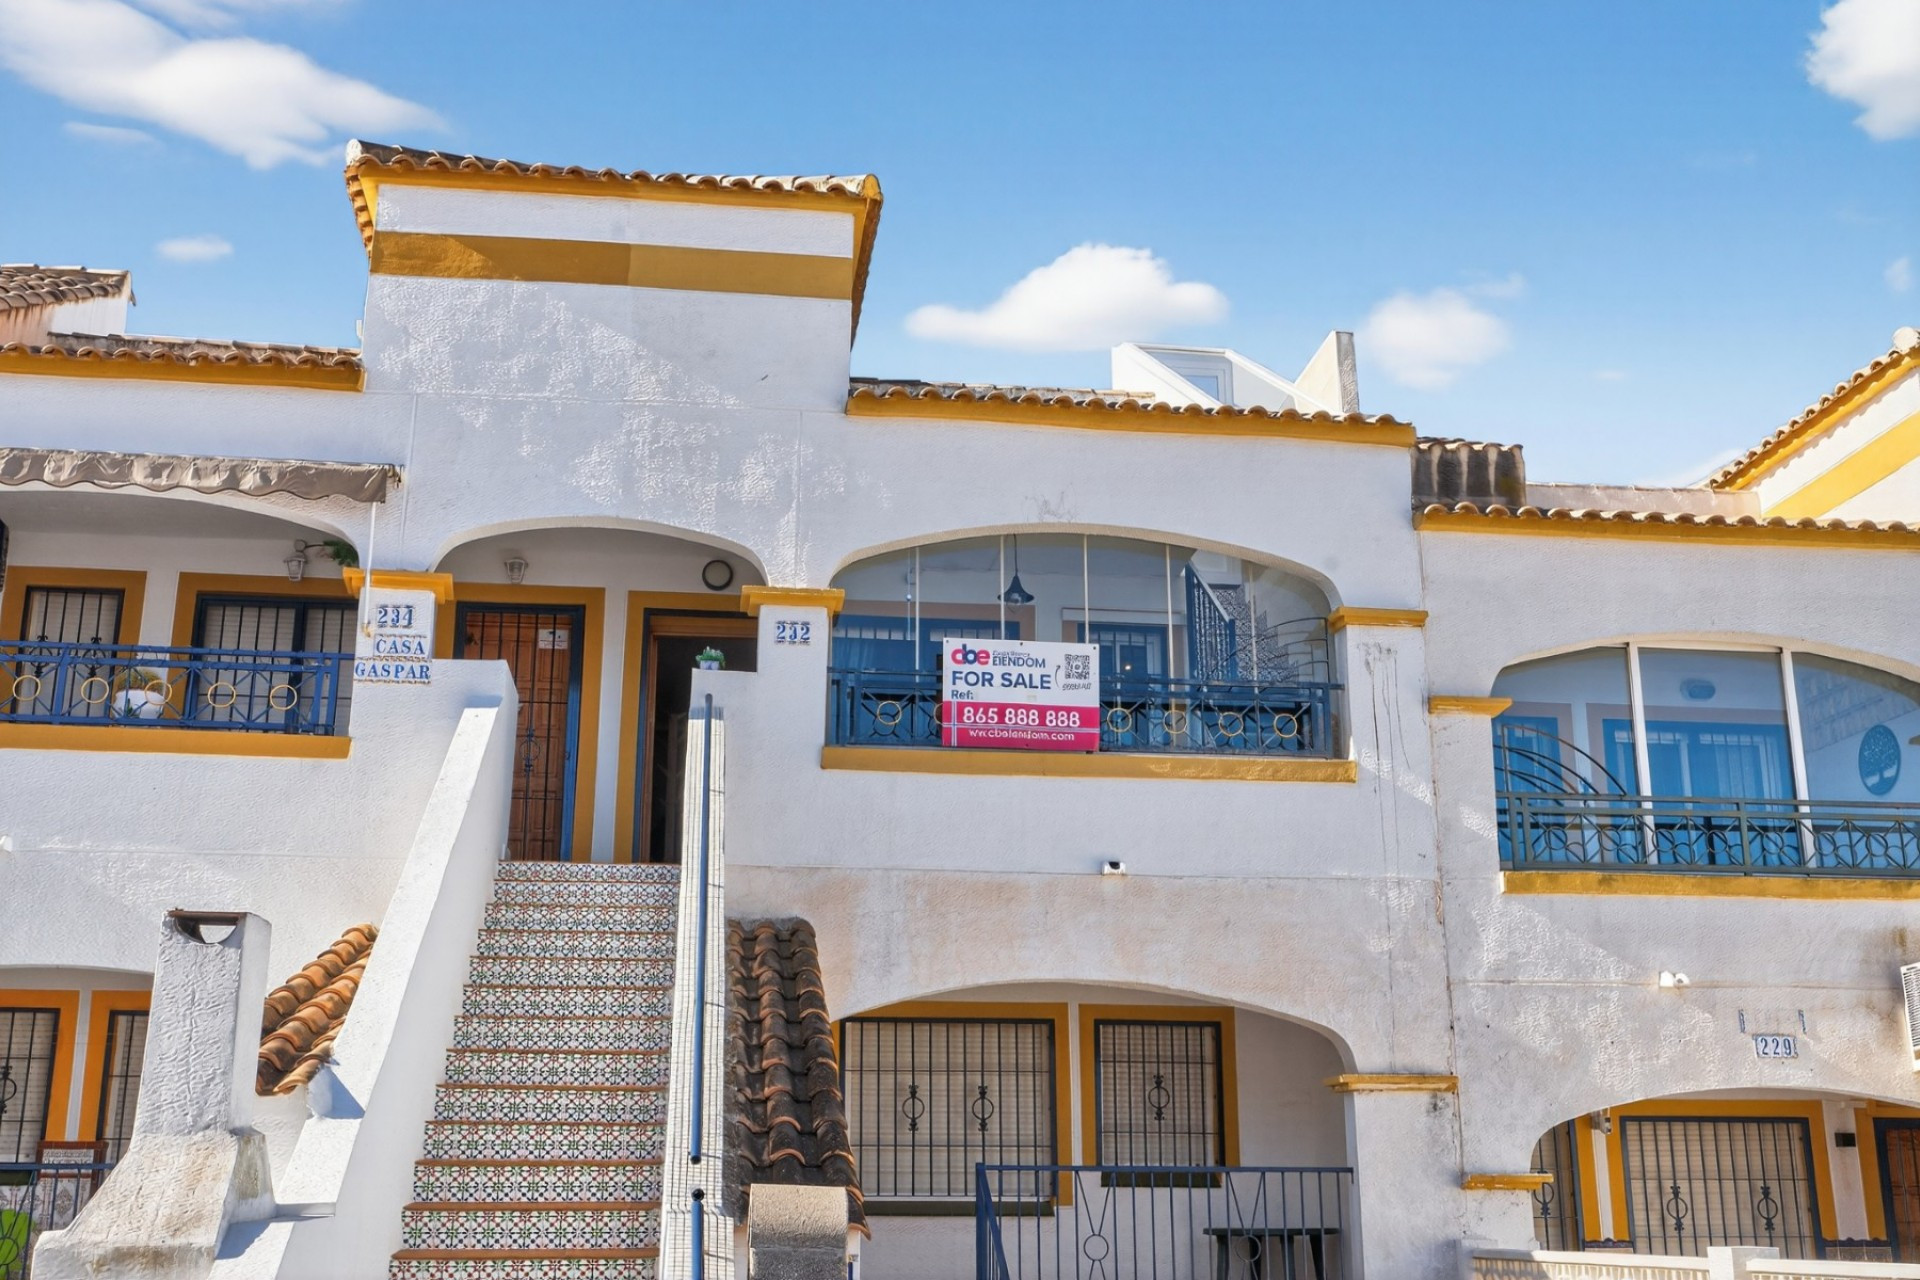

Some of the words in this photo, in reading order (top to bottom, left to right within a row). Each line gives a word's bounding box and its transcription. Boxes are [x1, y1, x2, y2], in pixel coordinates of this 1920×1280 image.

[377, 608, 413, 626] 234
[376, 639, 425, 655] CASA
[951, 644, 990, 666] cbe
[355, 662, 431, 679] GASPAR
[992, 655, 1046, 669] EIENDOM
[952, 671, 994, 687] FOR
[1001, 672, 1052, 690] SALE
[951, 690, 974, 700] Ref:
[963, 706, 998, 724] 865
[1005, 708, 1039, 726] 888
[1046, 710, 1080, 727] 888
[1760, 1037, 1792, 1056] 229
